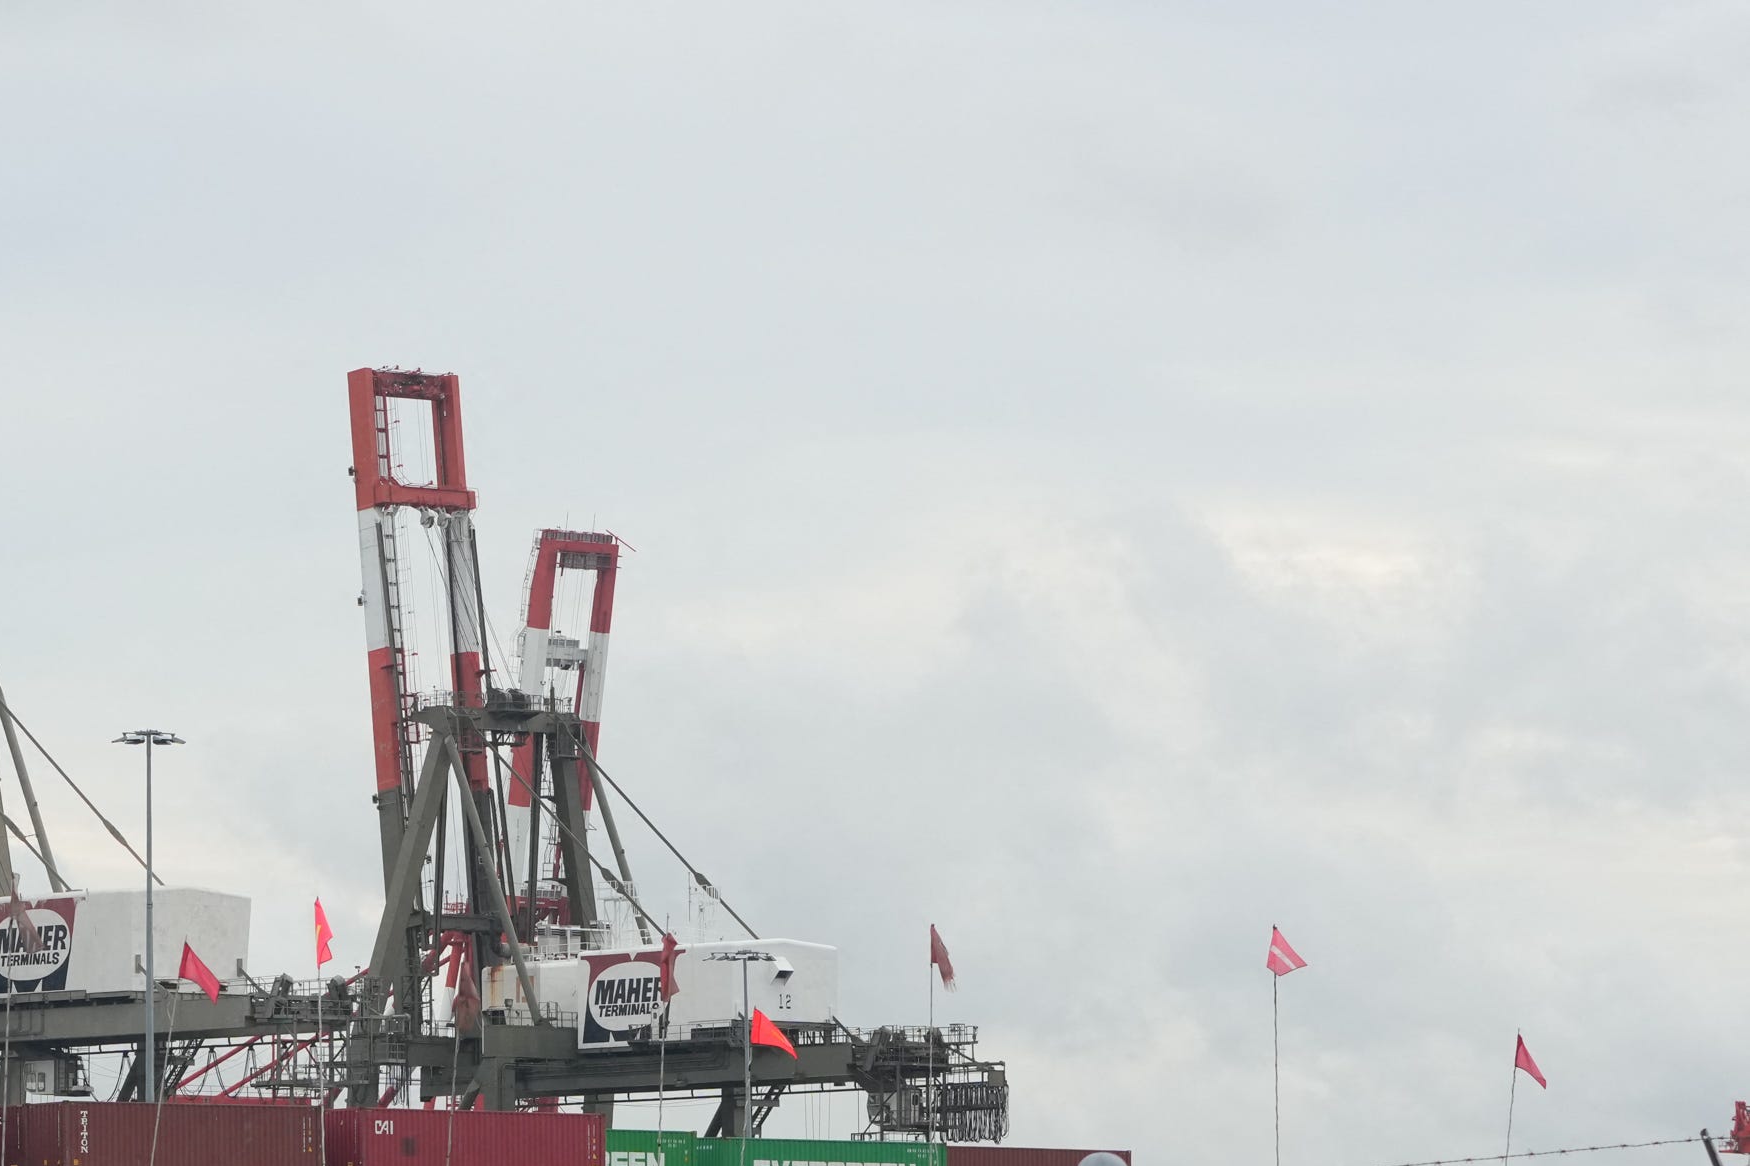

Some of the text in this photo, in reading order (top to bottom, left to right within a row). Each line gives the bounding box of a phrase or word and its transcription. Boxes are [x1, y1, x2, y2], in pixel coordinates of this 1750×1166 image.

[0, 952, 60, 967] TERMINALS
[598, 1003, 660, 1018] TERMINAL
[80, 1110, 89, 1154] TRITON
[374, 1119, 394, 1136] CAI
